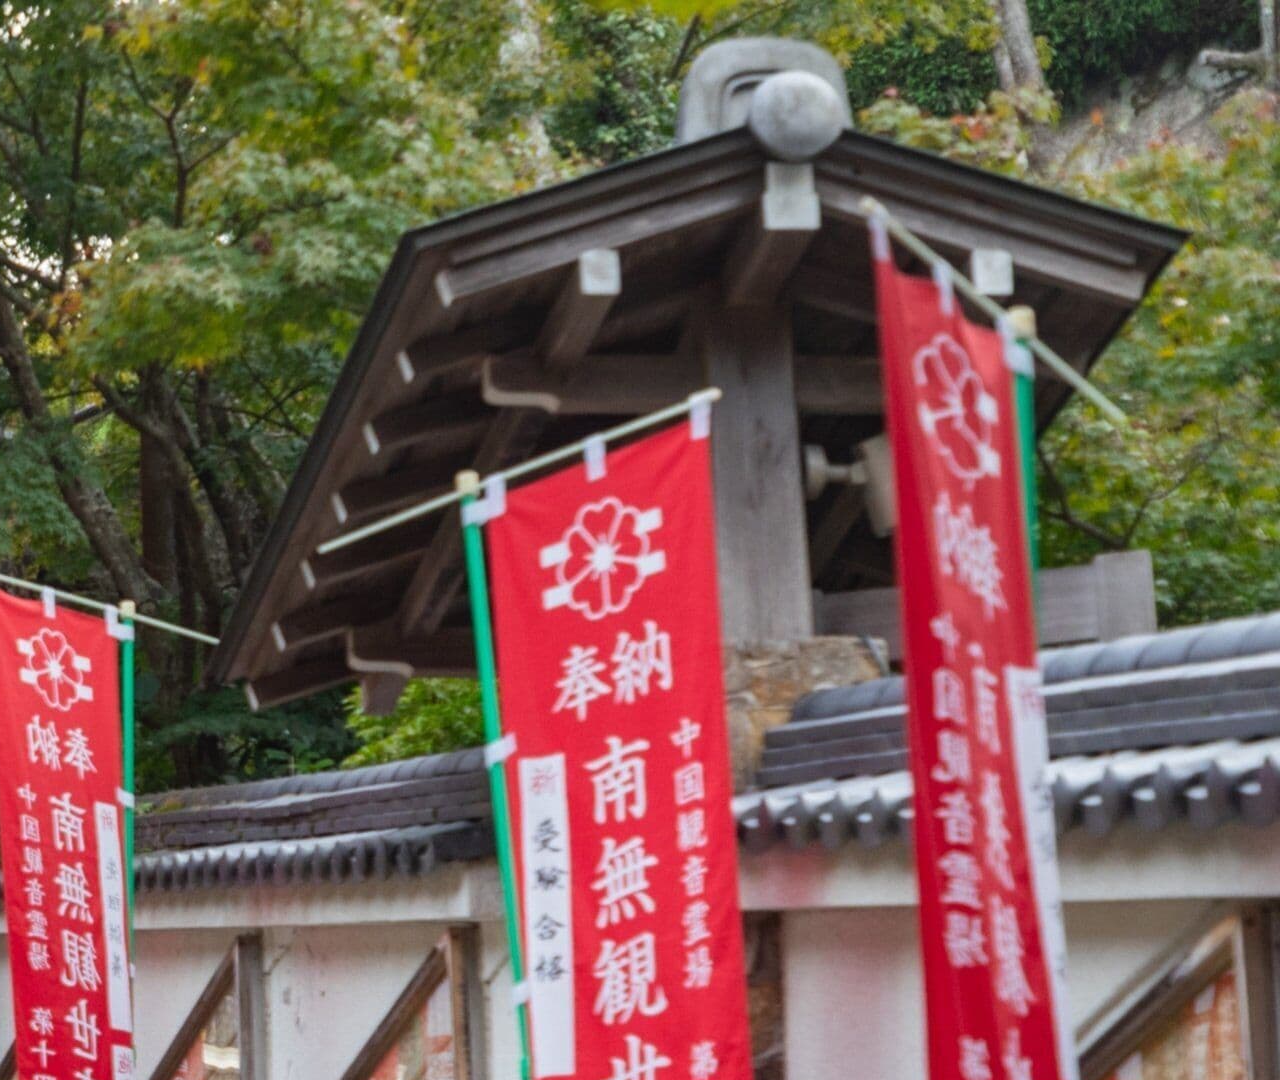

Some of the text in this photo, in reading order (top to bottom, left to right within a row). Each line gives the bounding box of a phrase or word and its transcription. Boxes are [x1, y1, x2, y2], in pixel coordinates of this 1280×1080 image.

[551, 620, 674, 721] 奉納
[533, 819, 568, 982] 受験合格
[670, 717, 713, 989] 中国観音霊場
